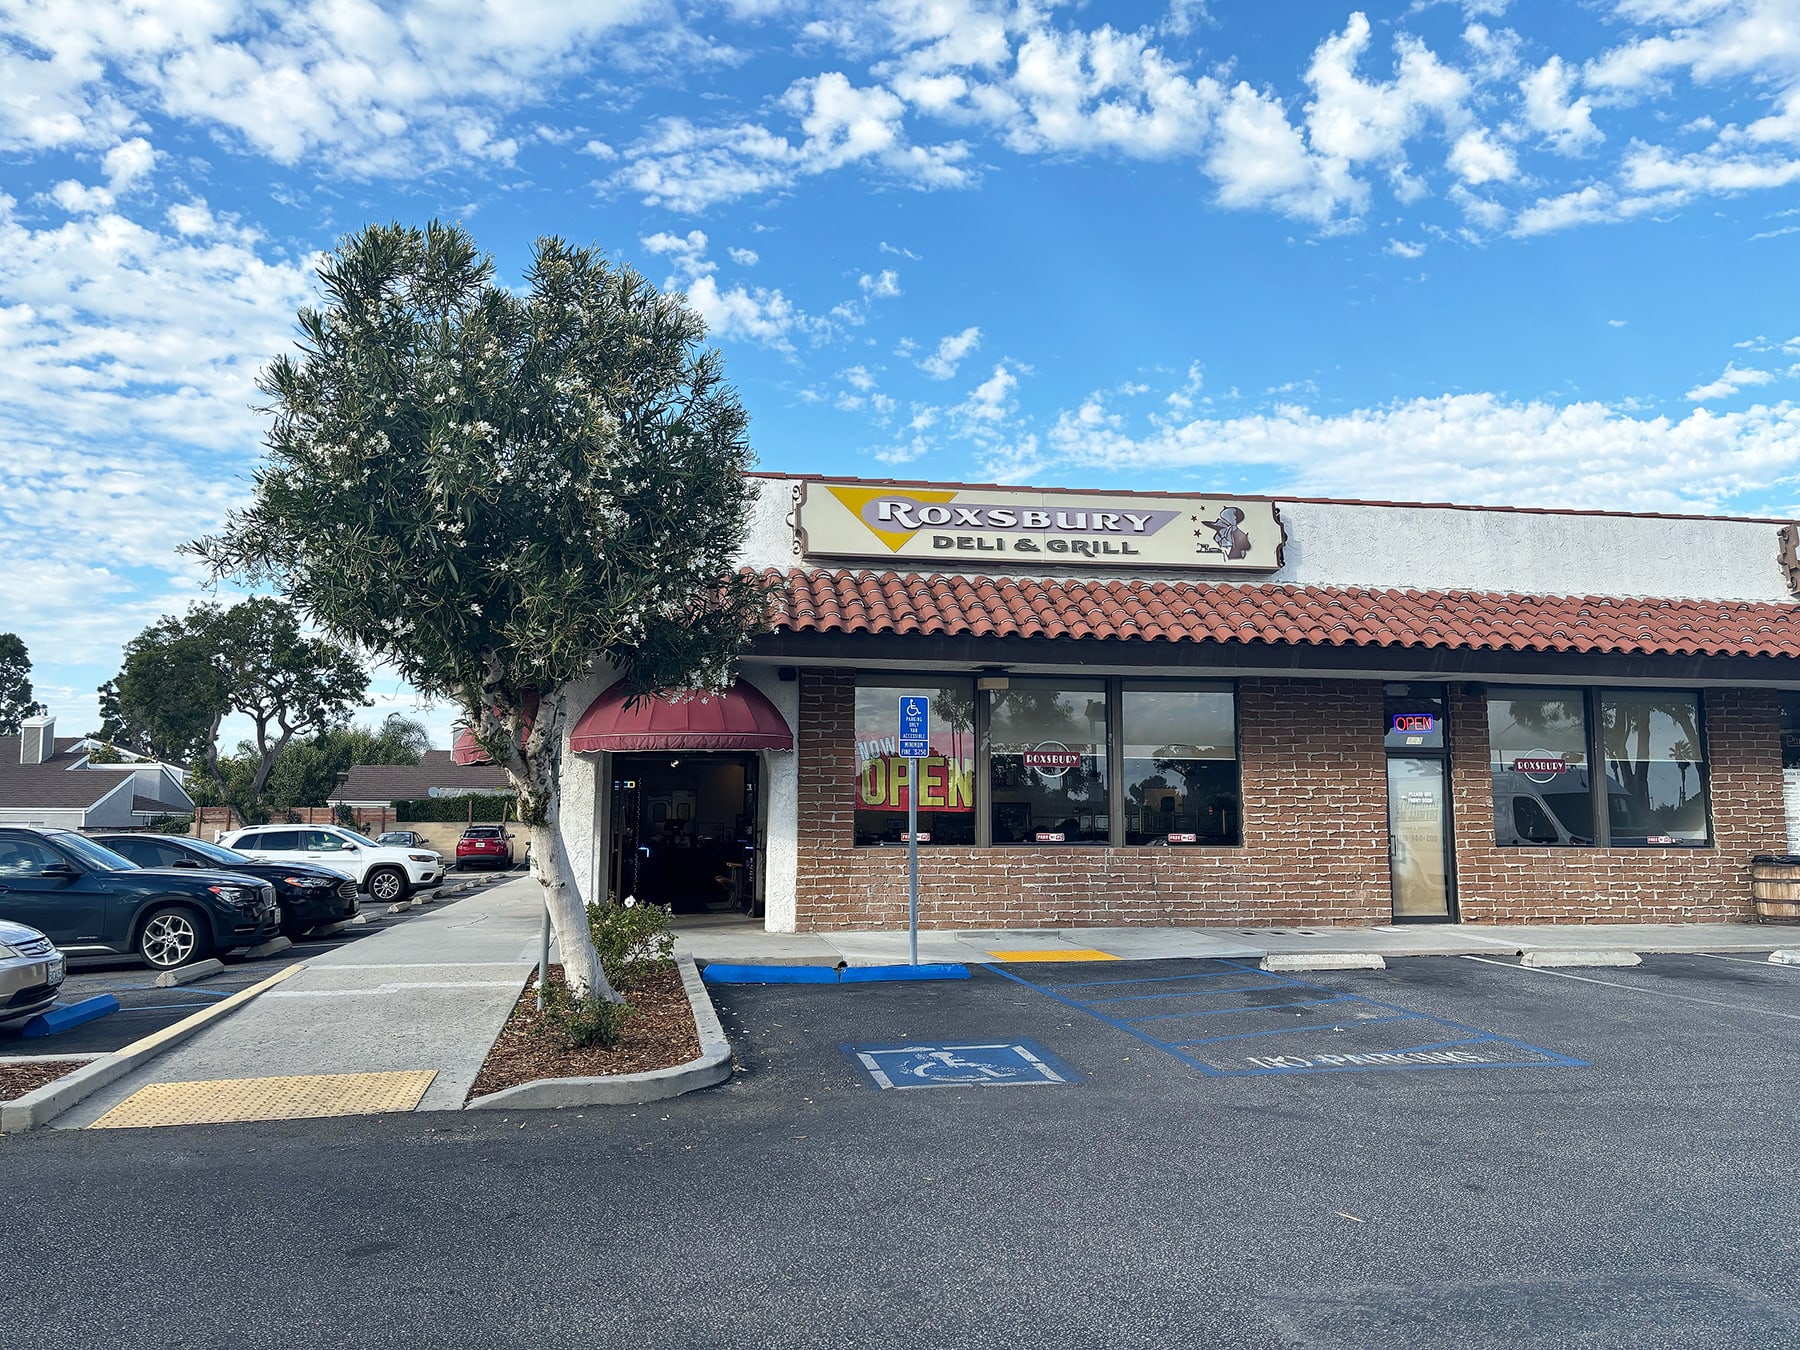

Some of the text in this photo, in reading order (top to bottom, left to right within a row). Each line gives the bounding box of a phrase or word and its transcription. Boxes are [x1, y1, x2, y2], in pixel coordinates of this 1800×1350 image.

[878, 501, 1152, 532] ROXSBURY
[932, 535, 1139, 557] DELI & GRILL
[1395, 716, 1433, 731] OPEN
[857, 735, 897, 761] NOW
[861, 757, 973, 808] OPEN
[1246, 1055, 1313, 1069] NO
